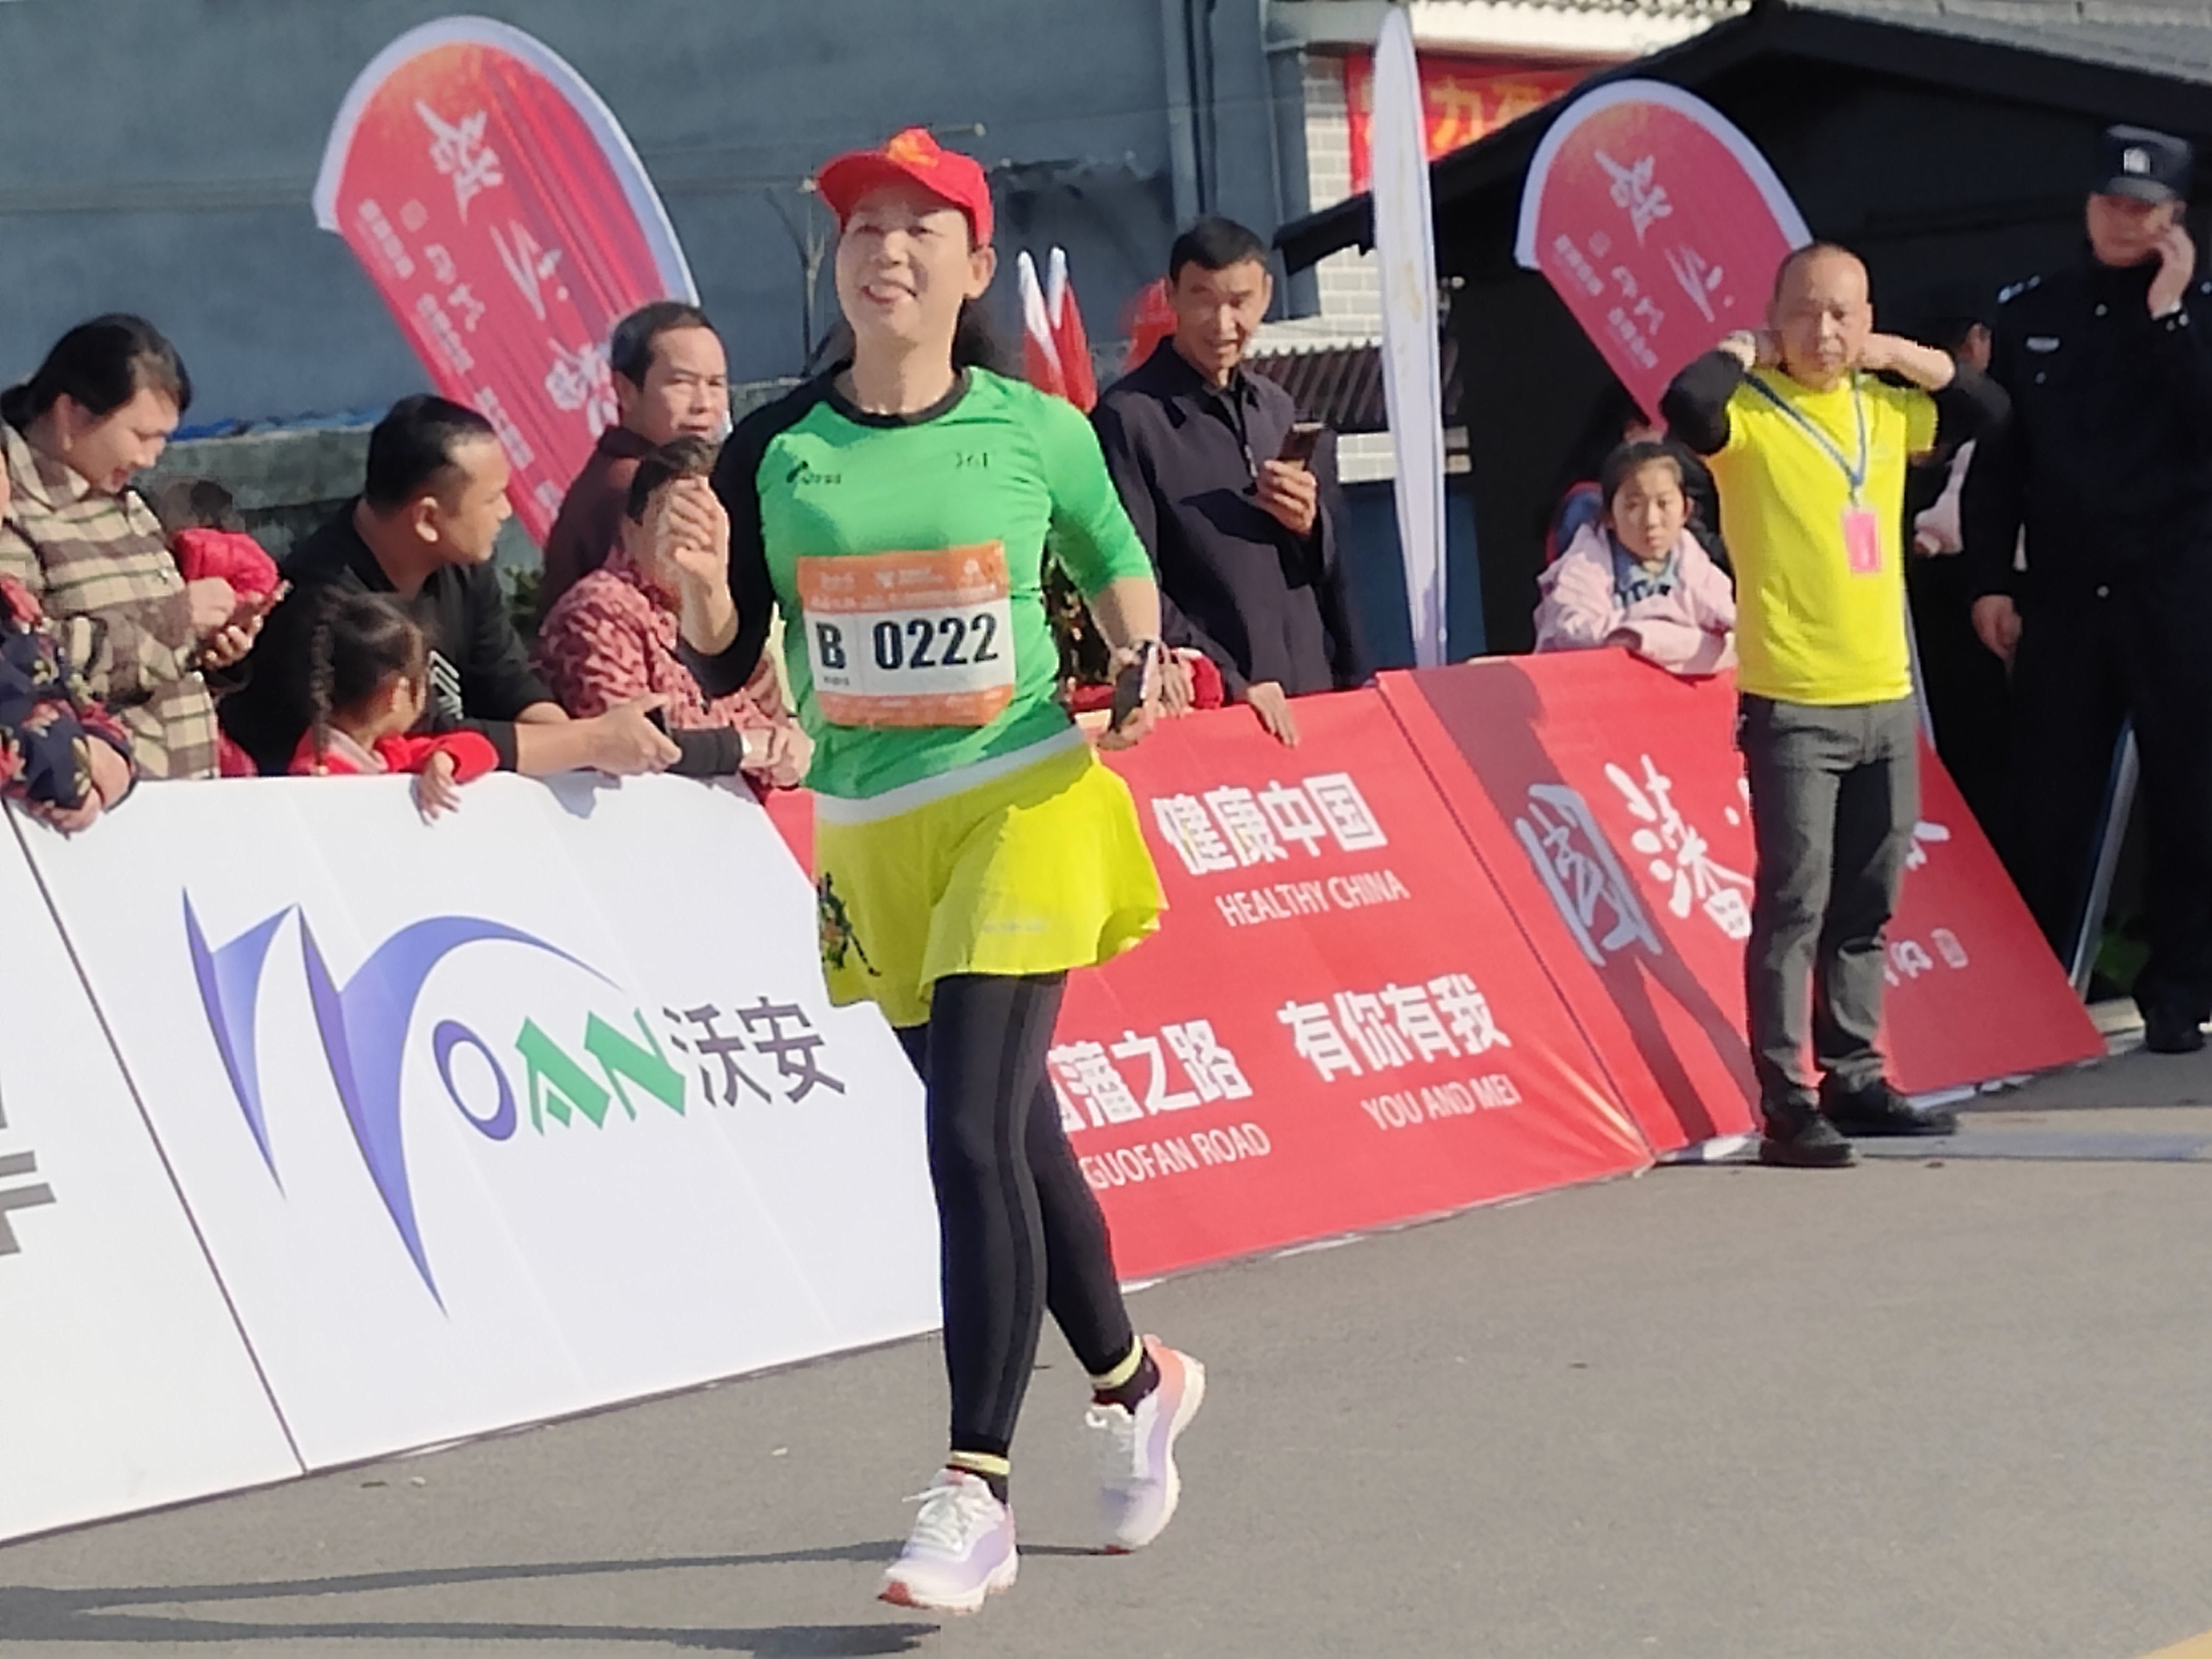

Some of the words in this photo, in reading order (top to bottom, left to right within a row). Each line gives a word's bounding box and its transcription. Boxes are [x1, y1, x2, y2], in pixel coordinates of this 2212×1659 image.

[815, 621, 846, 670] B
[873, 612, 999, 670] 0222
[1151, 772, 1388, 875] 健康中国
[1215, 881, 1331, 927] HEALTHY
[1327, 869, 1411, 909] CHINA
[662, 995, 846, 1108] 沃安
[1277, 973, 1512, 1082] 有你有我
[1048, 1019, 1253, 1133] 藩之路
[1360, 1090, 1424, 1131] YOU
[1420, 1081, 1476, 1120] AND
[1078, 1137, 1200, 1189] GUOFAN
[1190, 1122, 1272, 1166] ROAD
